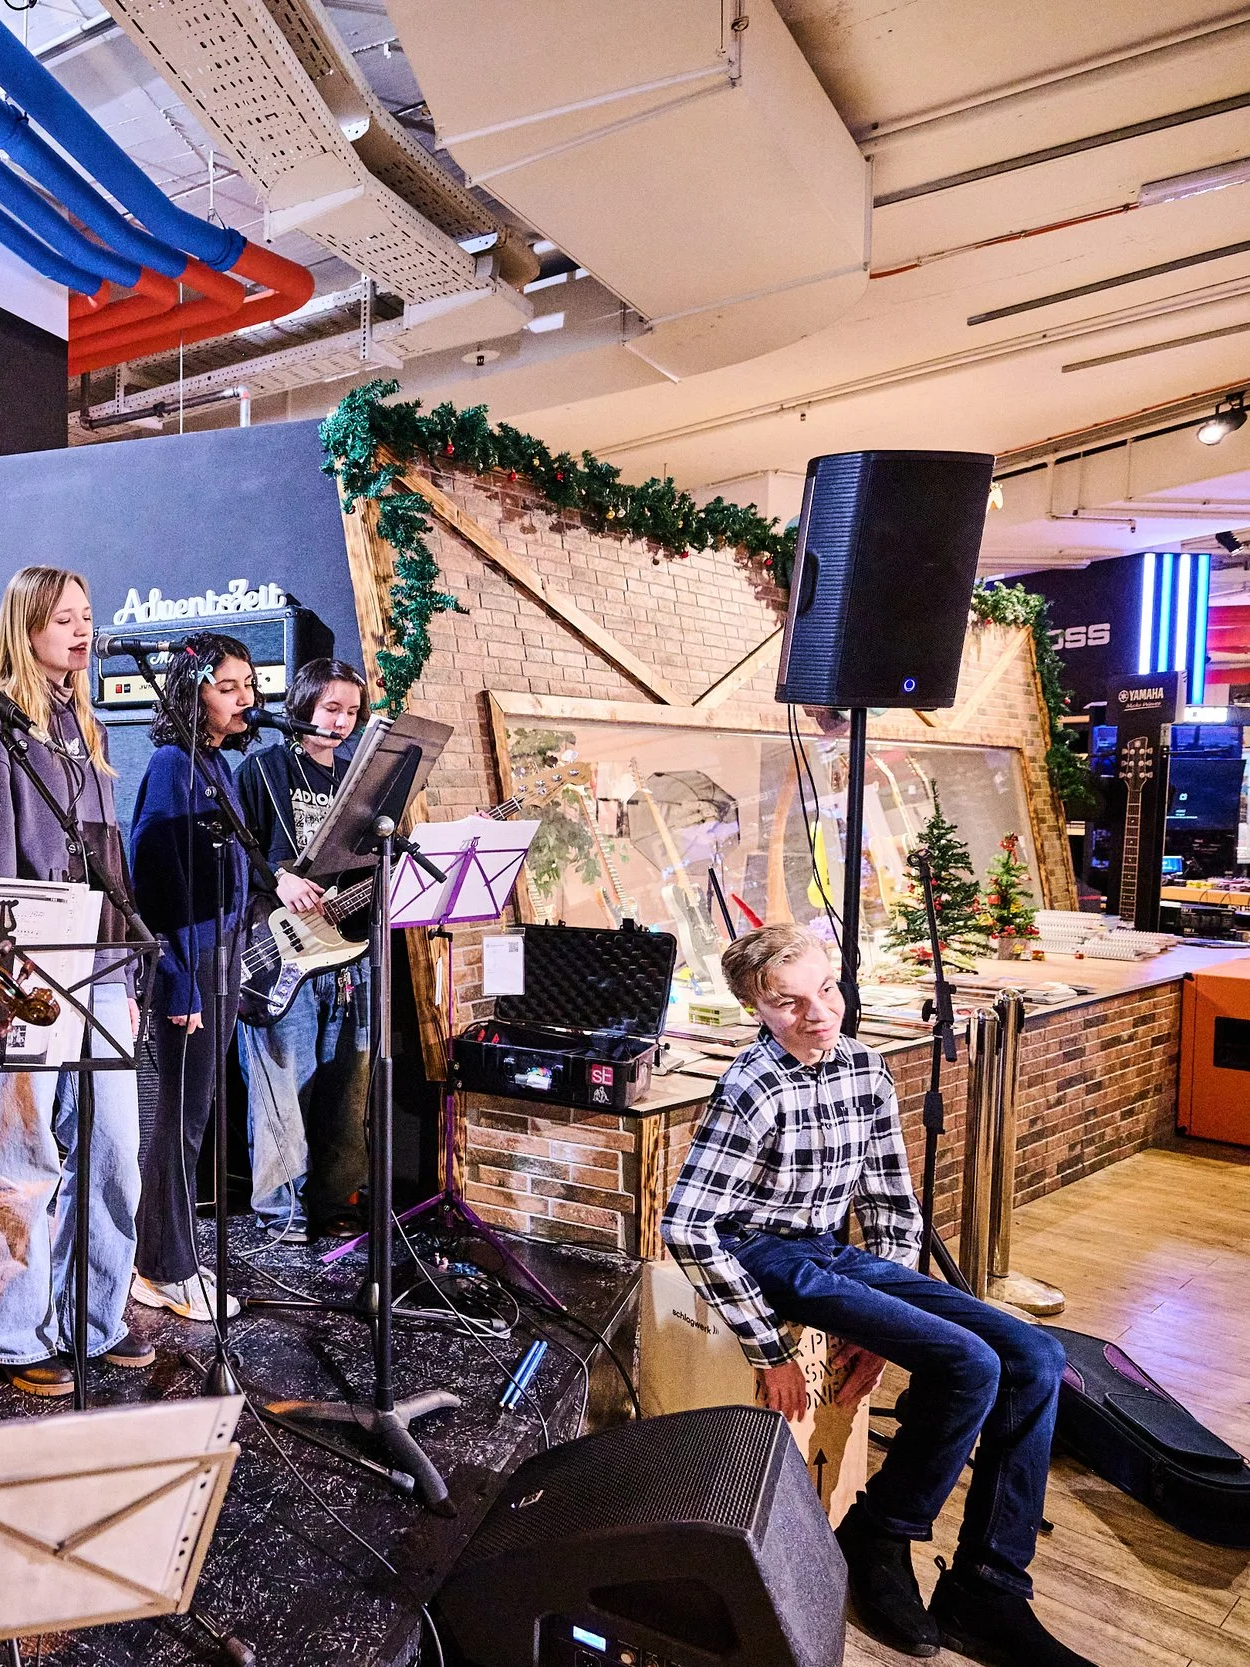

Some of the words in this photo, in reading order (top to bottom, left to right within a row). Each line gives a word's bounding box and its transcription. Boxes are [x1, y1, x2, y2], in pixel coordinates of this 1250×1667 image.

[1046, 623, 1110, 650] OSS
[1129, 687, 1164, 701] YAMAHA
[289, 788, 334, 806] ADIO
[672, 1309, 711, 1335] schlagwerk
